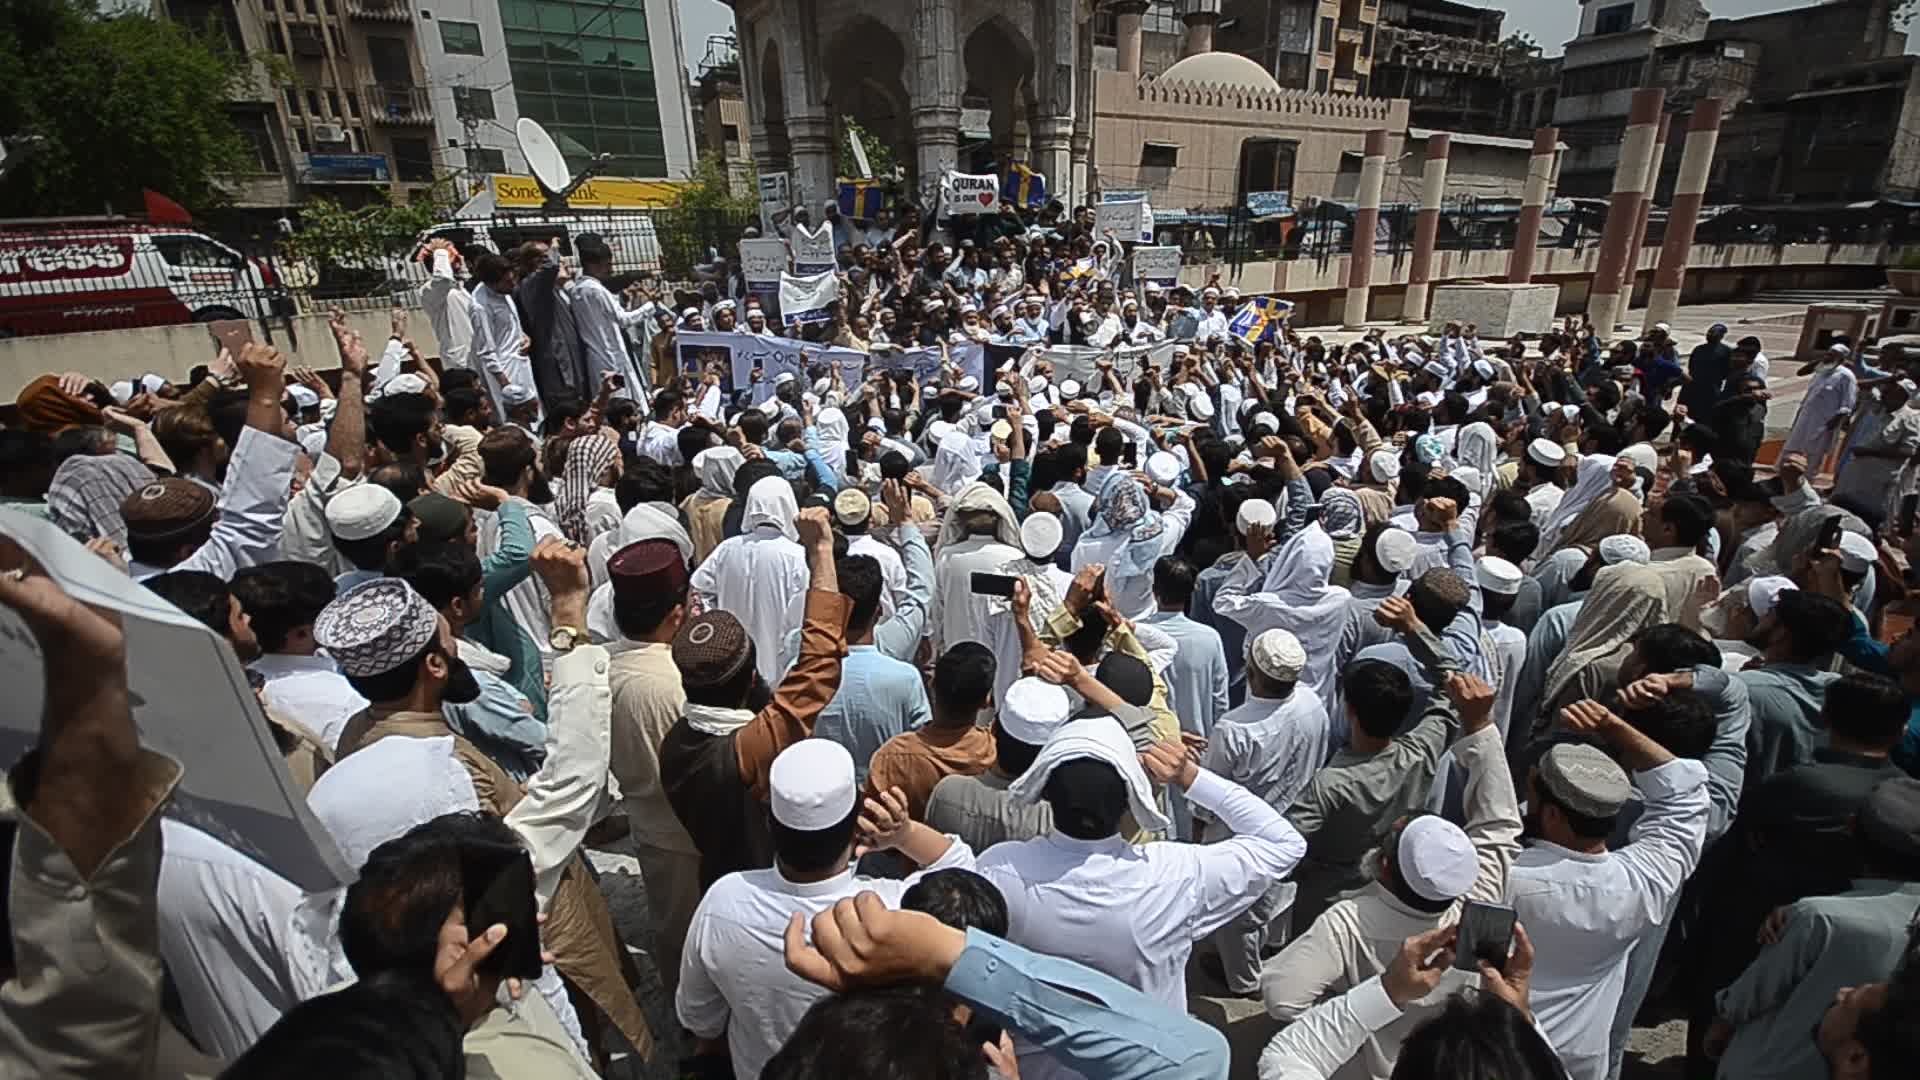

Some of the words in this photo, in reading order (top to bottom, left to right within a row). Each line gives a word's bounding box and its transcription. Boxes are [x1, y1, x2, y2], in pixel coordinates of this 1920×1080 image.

[498, 183, 541, 199] Sone
[571, 184, 599, 200] ank
[952, 178, 994, 192] QURAN
[0, 242, 125, 275] ress
